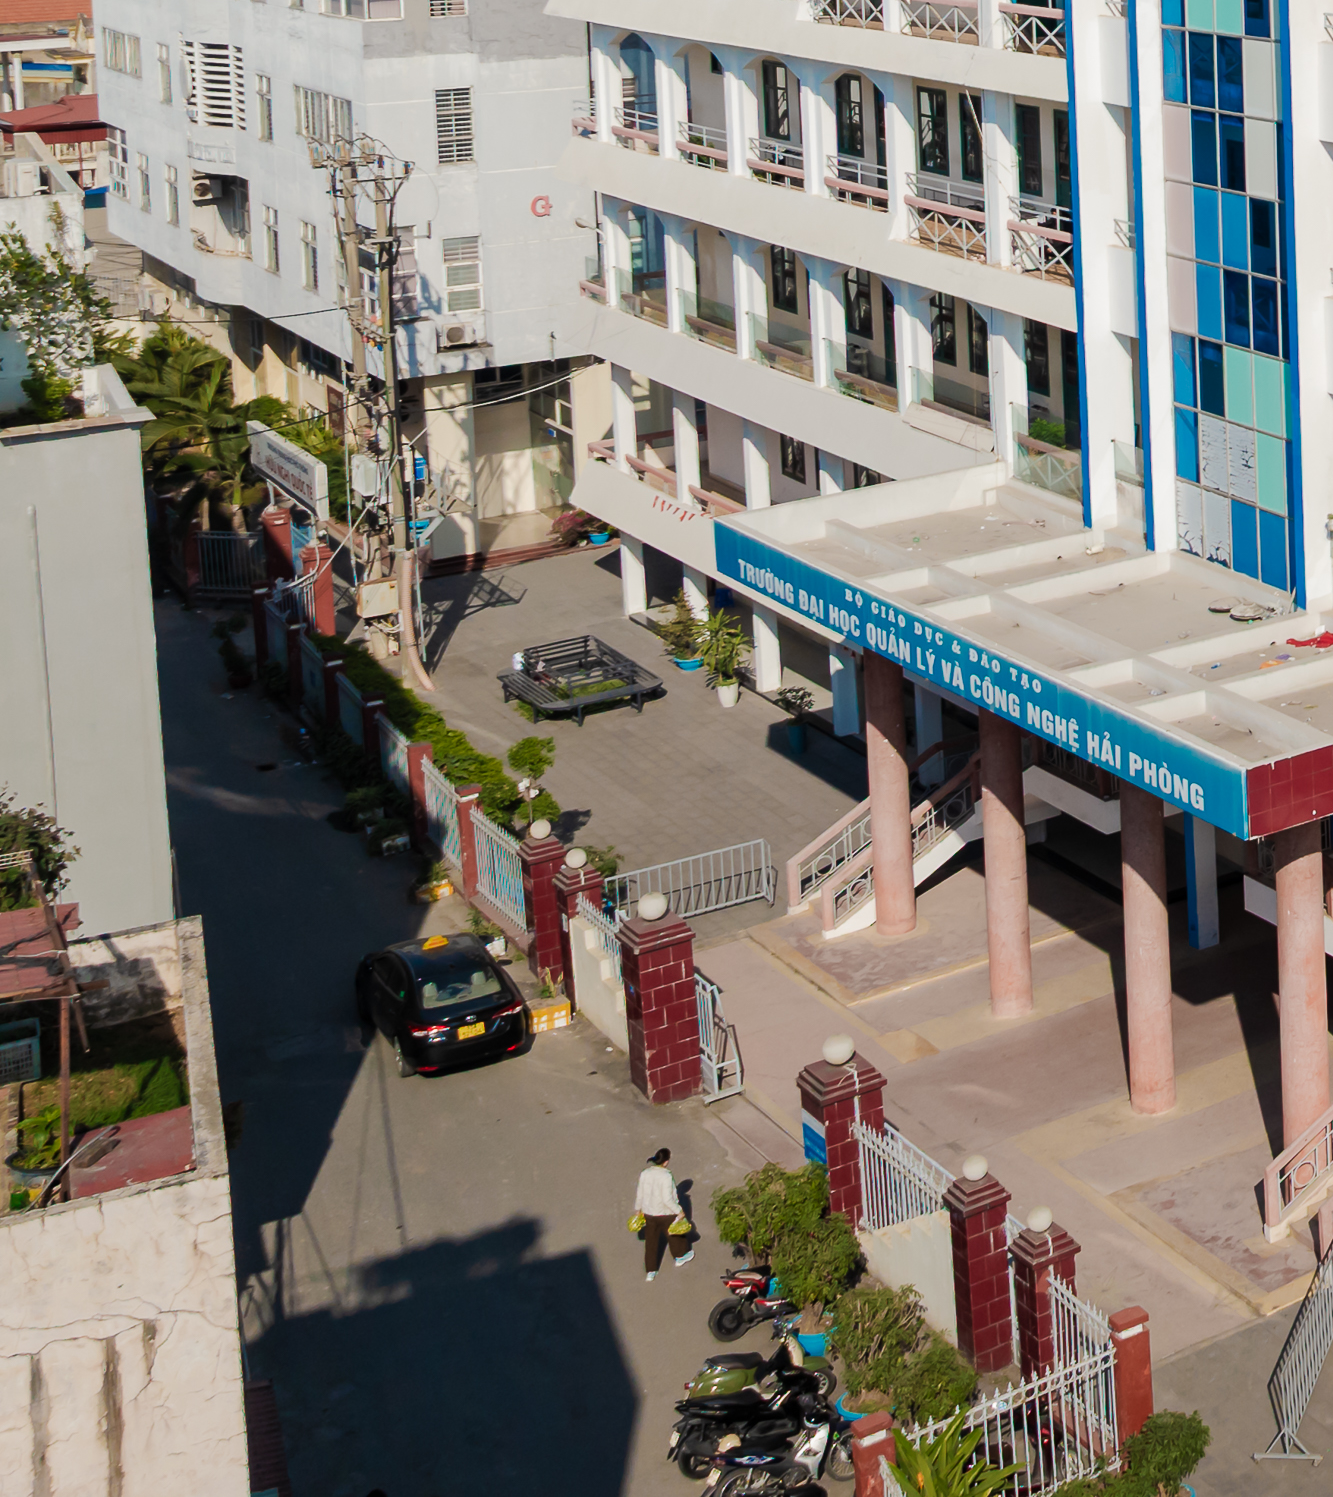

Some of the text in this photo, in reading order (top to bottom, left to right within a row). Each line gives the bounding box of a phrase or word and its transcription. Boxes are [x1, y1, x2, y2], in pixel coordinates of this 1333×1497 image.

[738, 558, 1204, 812] TRƯỜNG ĐẠI HỌC QUẢN LÝ VÀ CÔNG NGHỆ HẢI PHÒNG
[844, 588, 1042, 693] BỘ GIÁO DỤC & ĐÀO TẠO
